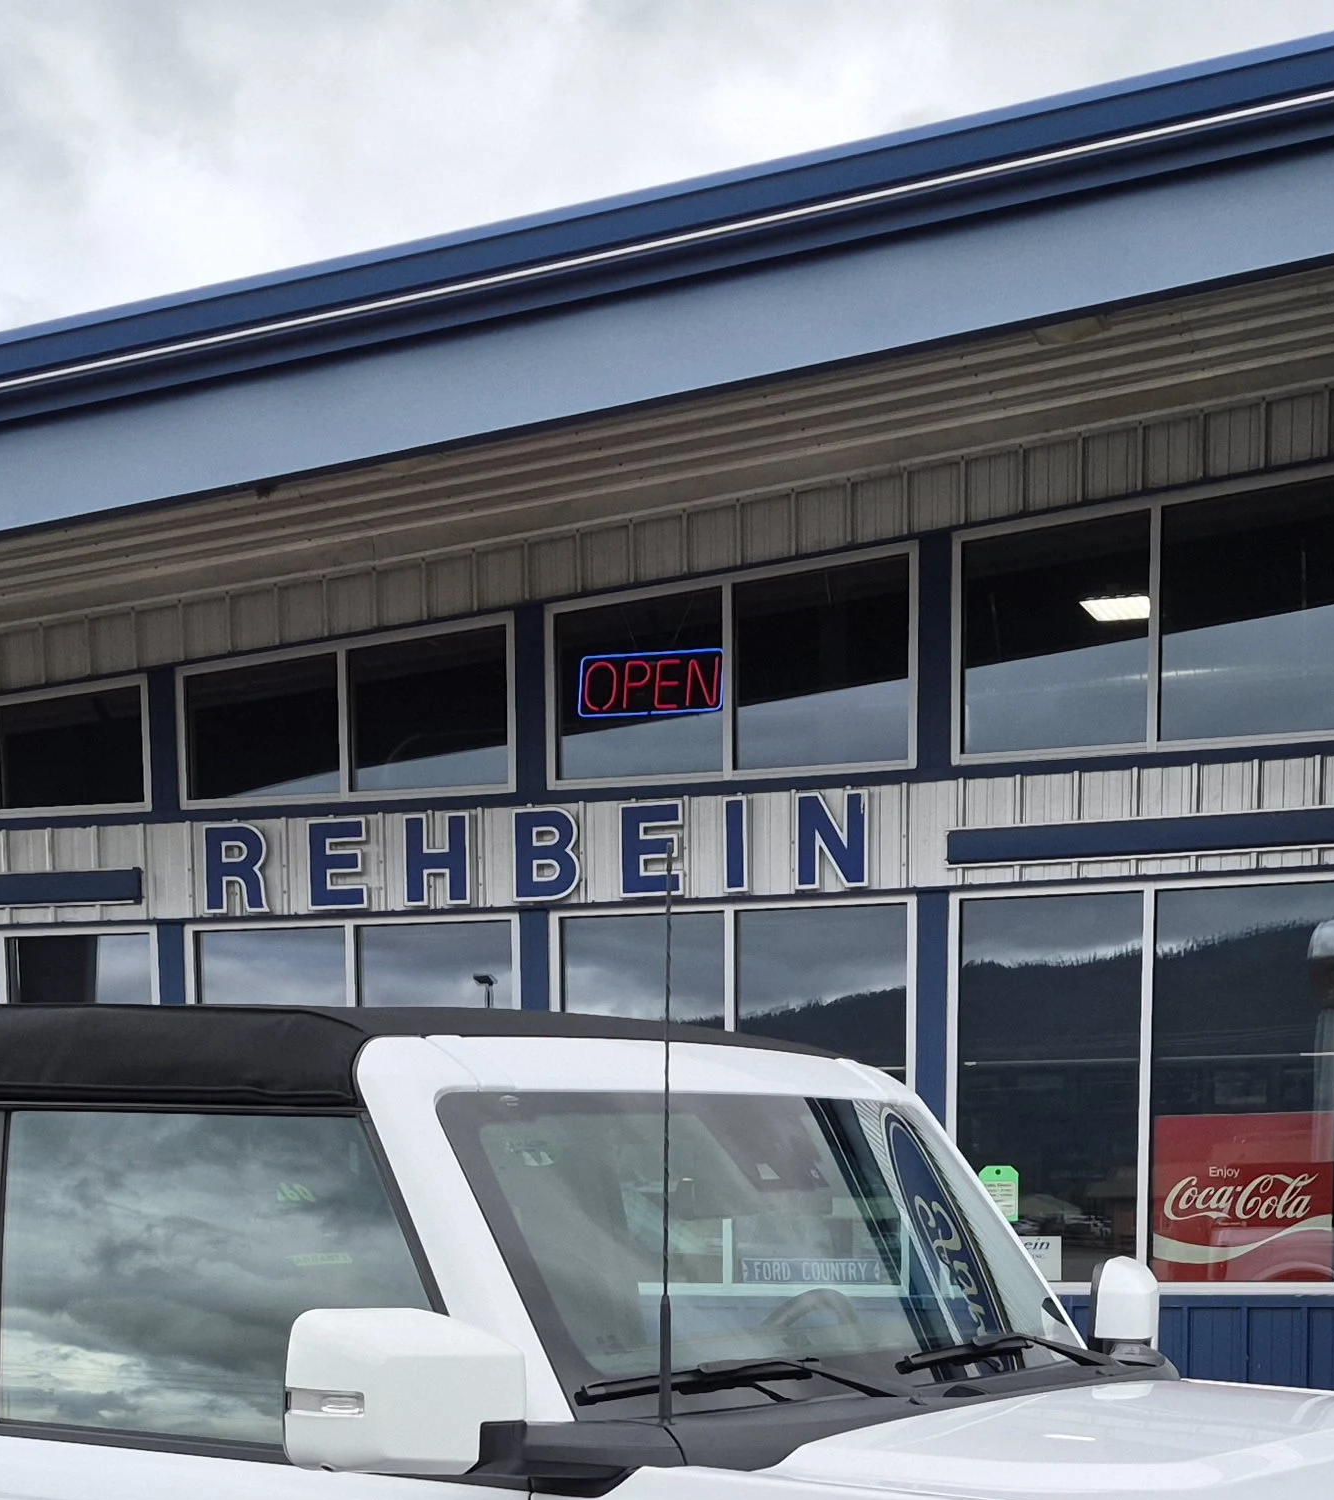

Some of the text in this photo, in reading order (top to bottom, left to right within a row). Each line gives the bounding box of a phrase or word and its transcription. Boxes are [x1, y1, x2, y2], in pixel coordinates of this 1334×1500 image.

[584, 656, 720, 711] OPEN
[202, 788, 869, 914] REHBEIN
[1163, 1172, 1320, 1221] Coca-Cola
[1208, 1166, 1240, 1178] Enjoy
[753, 1262, 868, 1281] FORD COUNTRY
